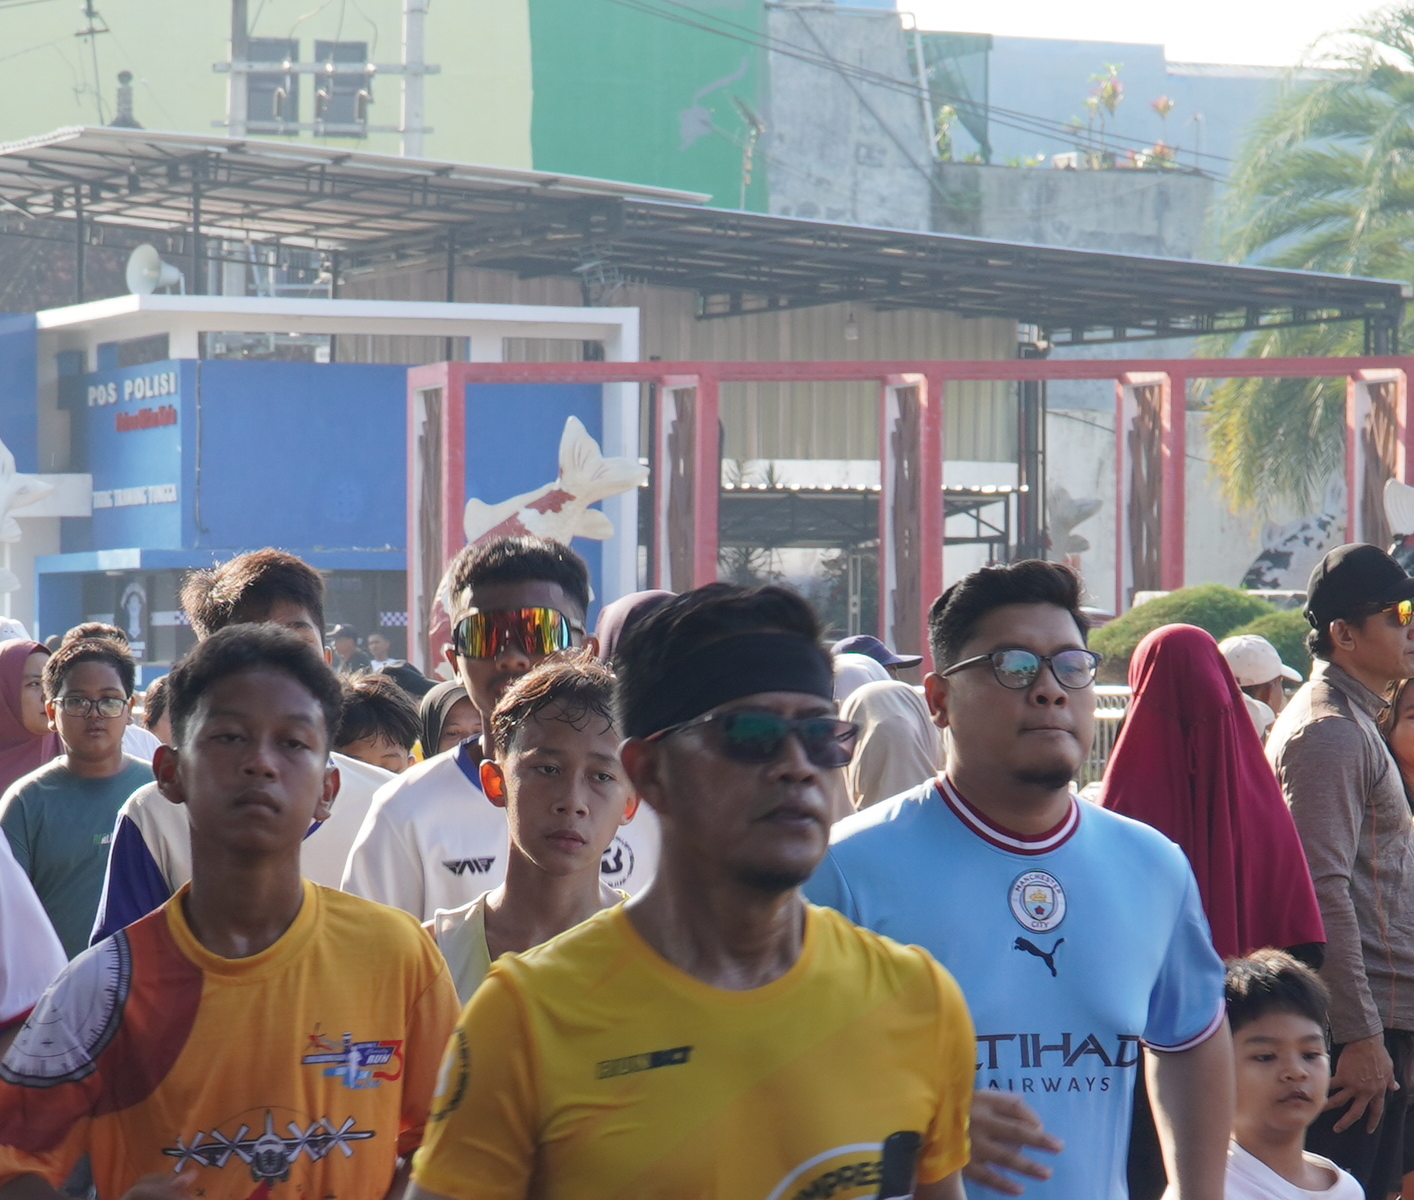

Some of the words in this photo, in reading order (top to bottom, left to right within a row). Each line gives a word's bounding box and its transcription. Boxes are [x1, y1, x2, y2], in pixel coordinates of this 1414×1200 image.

[88, 382, 118, 407] POS
[124, 371, 176, 401] POLISI
[1015, 874, 1062, 893] MANCHESTER
[366, 1053, 391, 1065] RUN
[975, 1033, 1139, 1070] TIHAD
[988, 1077, 1110, 1092] AIRWAYS
